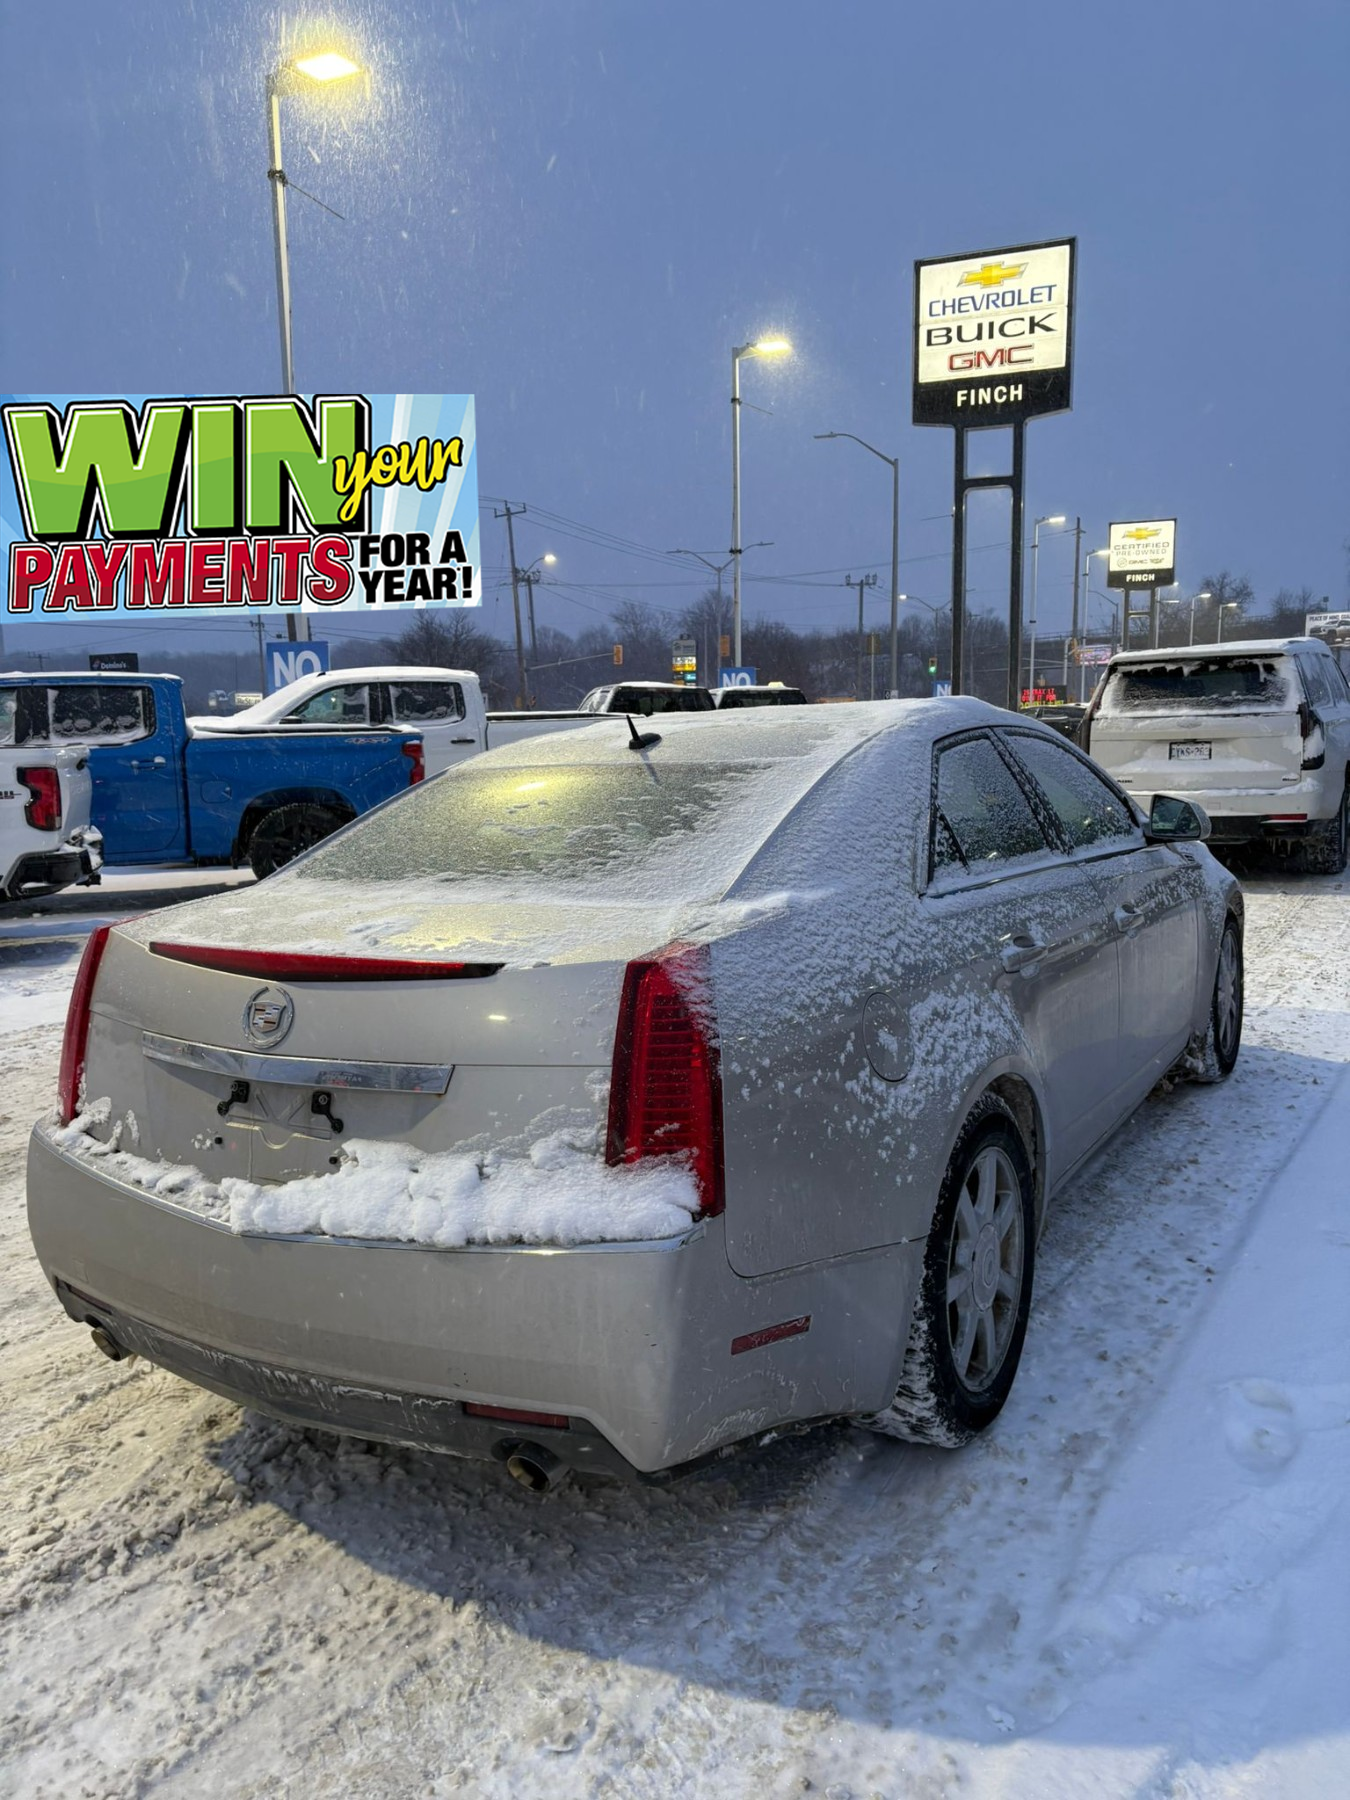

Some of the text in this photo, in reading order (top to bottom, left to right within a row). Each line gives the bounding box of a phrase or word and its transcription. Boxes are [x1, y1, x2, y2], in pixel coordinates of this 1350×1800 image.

[928, 284, 1057, 317] CHEVROLET
[926, 312, 1057, 347] BUICK
[948, 344, 1034, 372] GMC
[956, 383, 1023, 407] FINCH
[1114, 541, 1170, 551] CERTIFIED
[1116, 548, 1167, 556] PRE-OWNED
[1126, 574, 1155, 582] FINCH
[100, 661, 127, 669] Domino's
[273, 651, 321, 687] NO
[722, 672, 751, 688] NO
